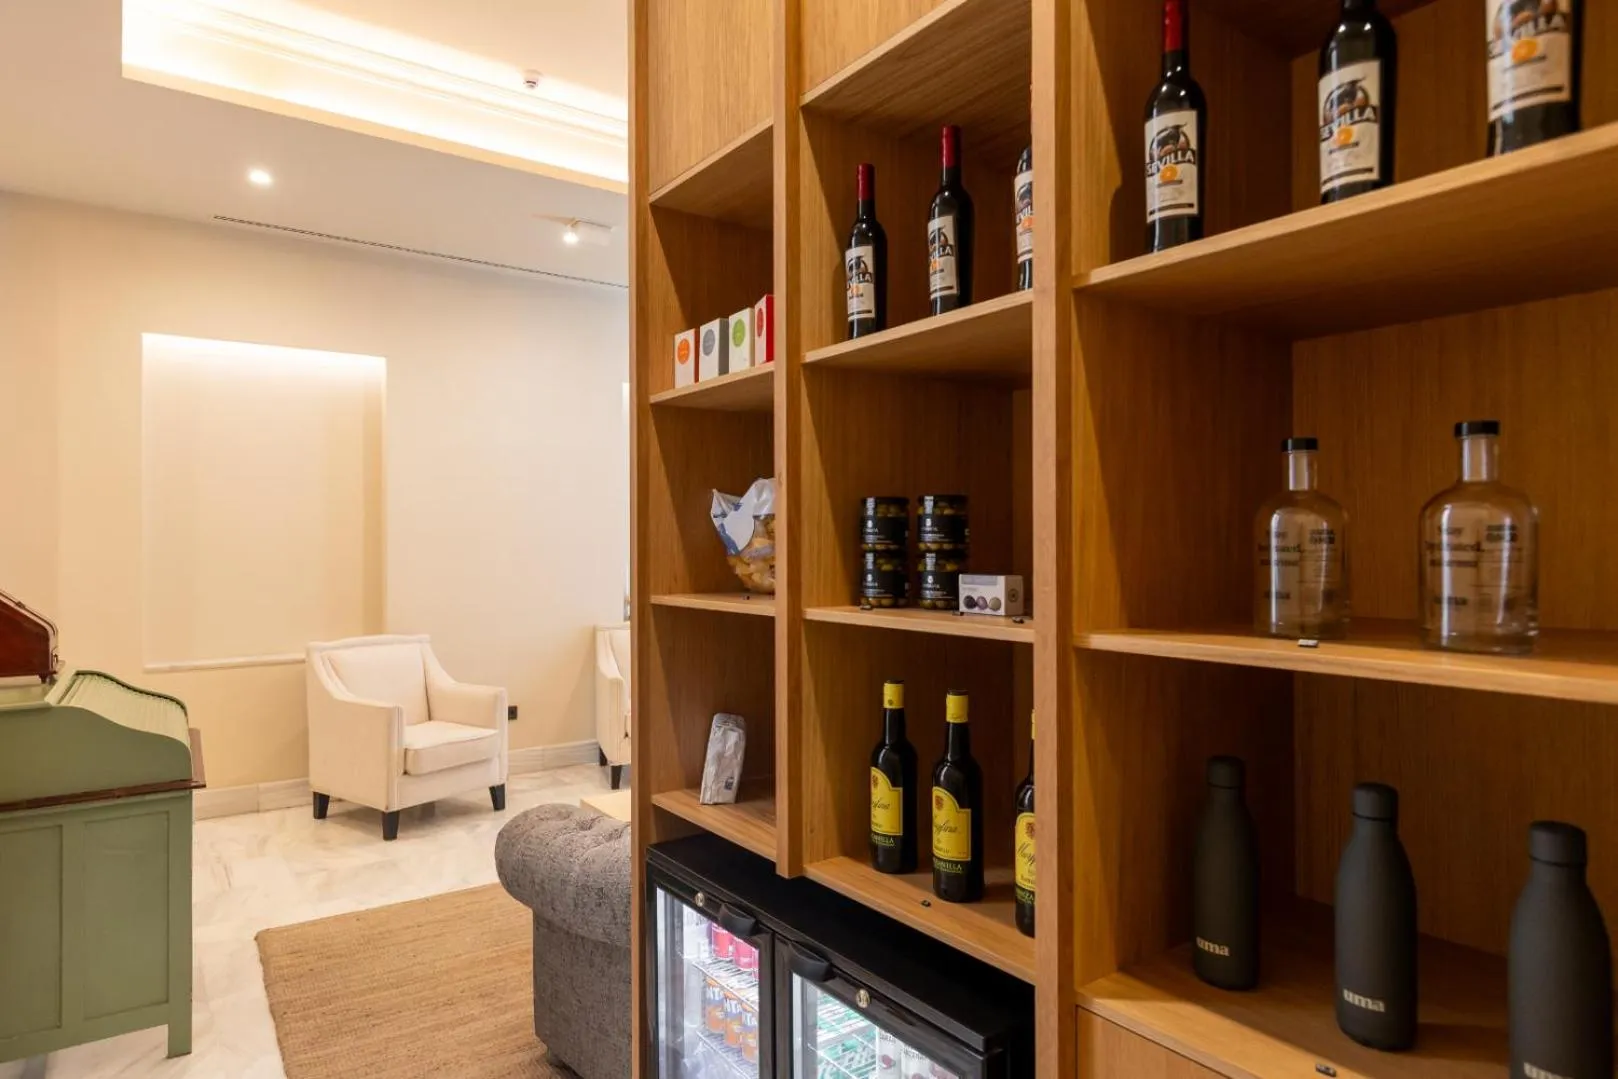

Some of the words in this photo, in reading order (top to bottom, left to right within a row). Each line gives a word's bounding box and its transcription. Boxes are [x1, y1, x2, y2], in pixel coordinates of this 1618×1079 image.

[1196, 936, 1230, 957] uma
[1343, 989, 1386, 1013] uma
[1523, 1062, 1574, 1079] um
